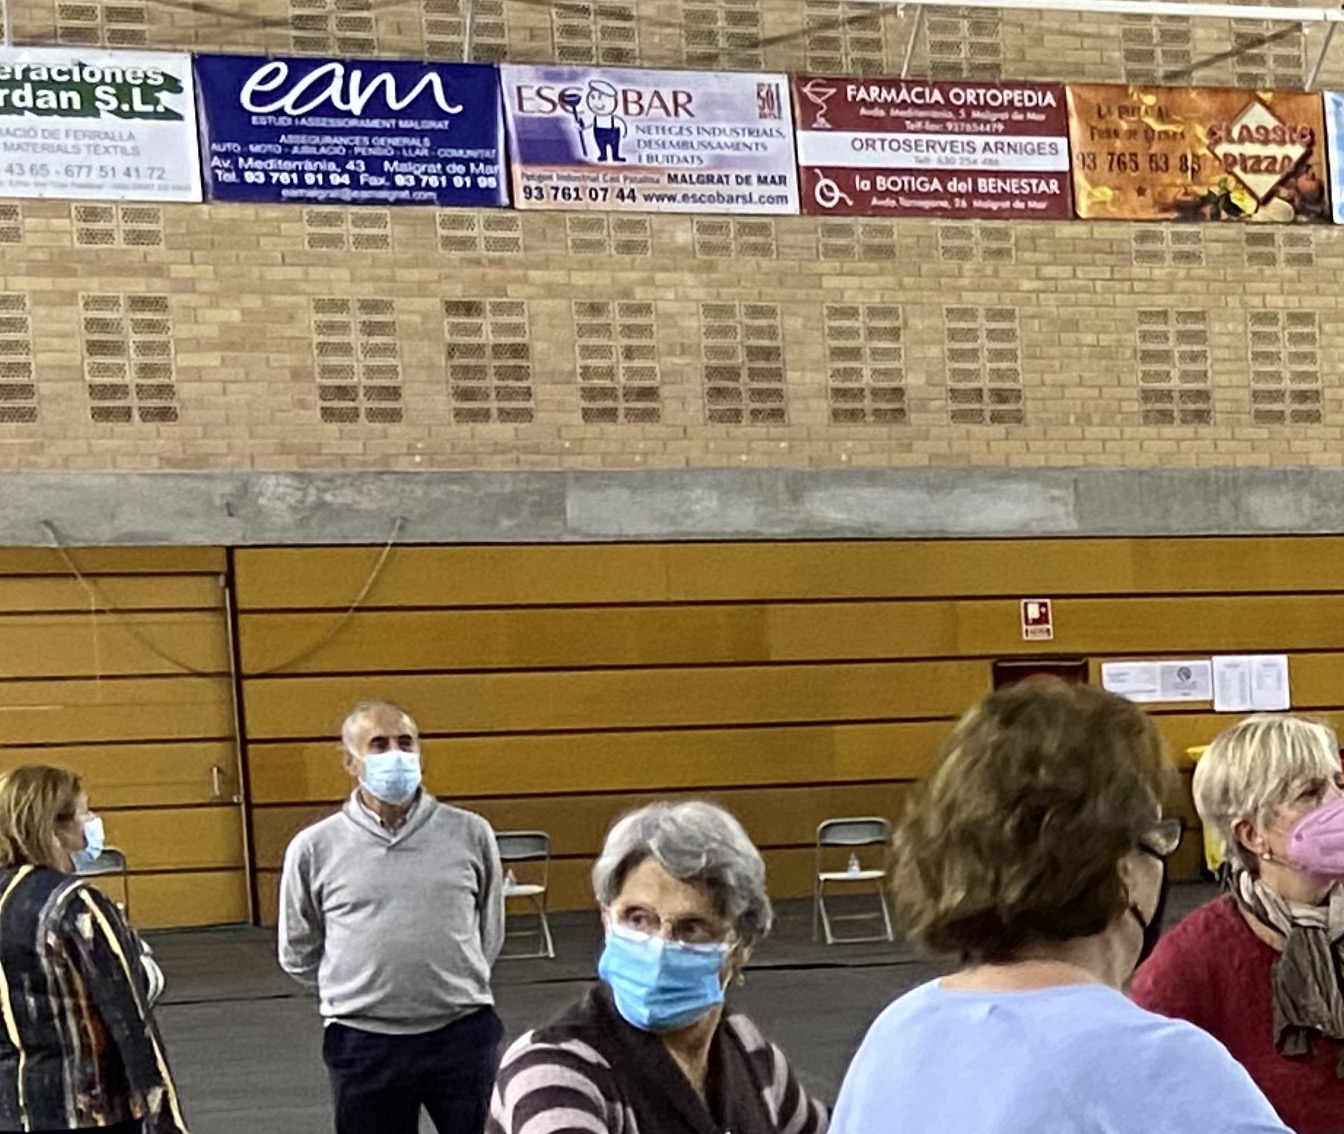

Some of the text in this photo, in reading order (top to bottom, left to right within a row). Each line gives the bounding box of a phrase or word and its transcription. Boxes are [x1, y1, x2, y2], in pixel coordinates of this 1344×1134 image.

[240, 61, 463, 116] eam
[846, 81, 1057, 108] FARMÀCIA ORTOPEDIA
[95, 85, 165, 112] S.L.
[1026, 112, 1047, 121] Mar
[41, 129, 60, 140] DE
[65, 129, 136, 142] FERRALLA
[636, 124, 693, 136] NETEGES
[3, 142, 83, 155] MATERIALS
[280, 134, 431, 148] ASSEGURANCES GENERALS
[636, 138, 768, 152] DESEMBUSSAMENTS
[850, 137, 1059, 156] ORTOSERVEIS ARNIGES
[211, 142, 241, 153] AUTO
[249, 143, 282, 154] MOTO
[402, 148, 429, 157] LLAR
[437, 148, 497, 159] COMUNITAT
[211, 156, 233, 169] Av.
[345, 160, 365, 173] 43
[383, 160, 442, 176] Malgrat
[446, 162, 466, 175] de
[470, 163, 499, 175] Mar
[645, 153, 704, 166] BUIDATS
[1107, 151, 1139, 173] 765
[1222, 152, 1296, 175] PIZZA
[4, 163, 25, 177] 43
[65, 165, 92, 178] 677
[100, 165, 116, 178] 51
[123, 166, 141, 179] 41
[147, 166, 166, 180] 72
[269, 172, 298, 185] 761
[421, 175, 447, 188] 761
[667, 173, 731, 186] MALGRAT
[735, 174, 751, 186] DE
[757, 174, 788, 187] MAR
[855, 174, 1061, 195] la BOTIGA del BENESTAR
[523, 185, 789, 206] 93 761 07 44 www.escobarsl.com
[1027, 200, 1048, 210] Mar
